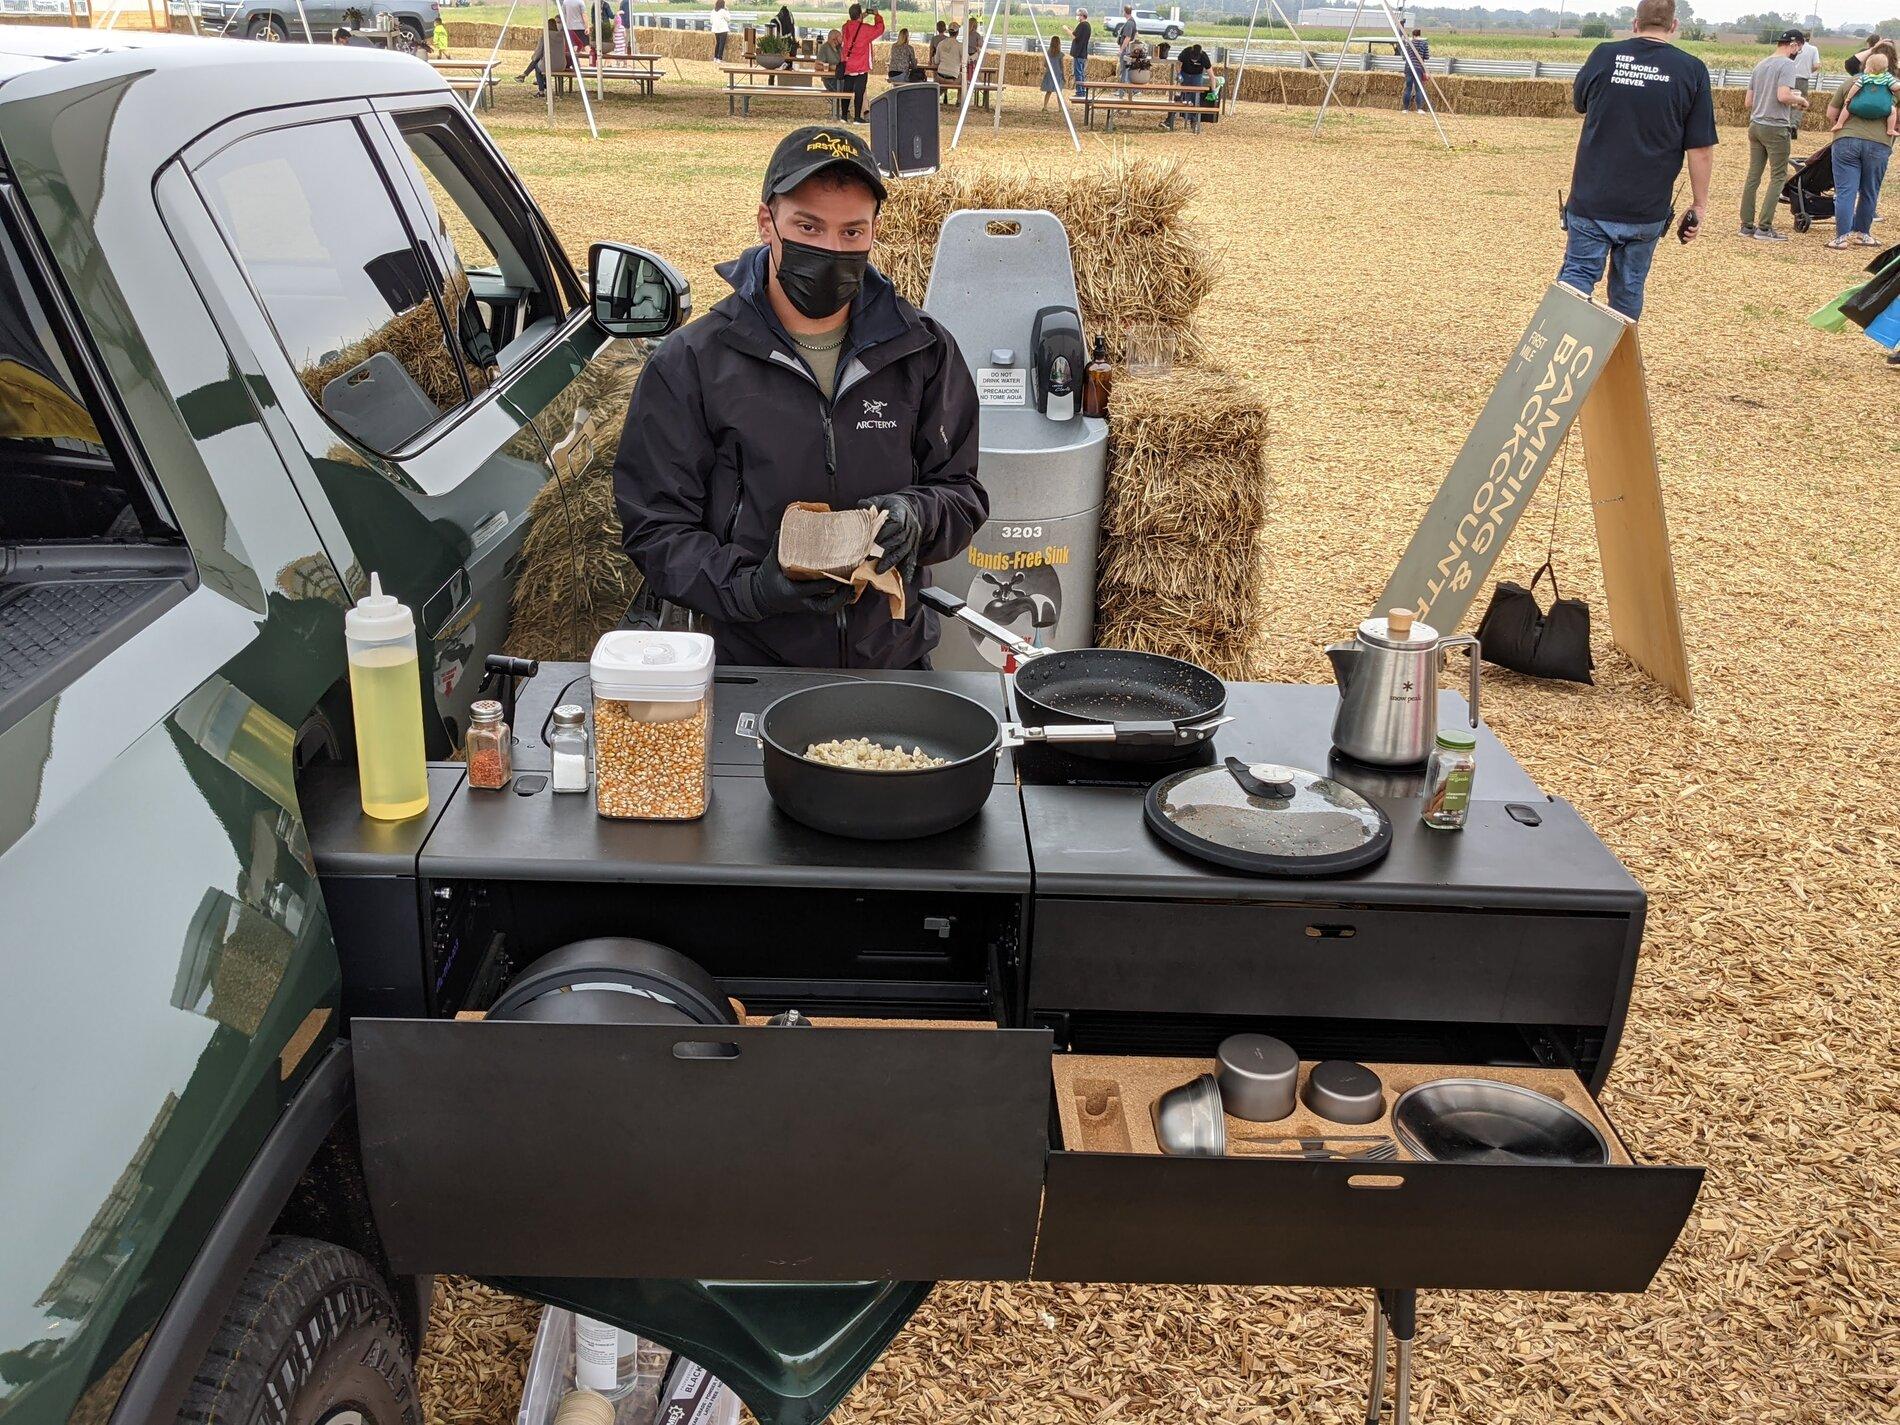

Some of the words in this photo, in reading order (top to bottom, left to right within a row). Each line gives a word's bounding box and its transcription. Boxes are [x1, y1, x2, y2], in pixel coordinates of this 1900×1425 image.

[1615, 54, 1635, 62] KEEP
[1612, 69, 1670, 82] ADVENTUROUS
[1615, 61, 1630, 70] THE
[1630, 64, 1659, 73] WORLD
[1610, 76, 1645, 87] FOREVER.
[806, 142, 833, 152] FIRST
[837, 143, 859, 157] MILE
[1528, 331, 1548, 350] FIRST
[1471, 345, 1594, 555] CAMPING
[1411, 333, 1578, 622] BACKCOUNTR
[1001, 526, 1042, 538] 3203
[967, 544, 1043, 571] Hands-Free
[1044, 544, 1070, 565] Sink
[1448, 560, 1472, 592] &
[685, 1365, 703, 1393] BLACK
